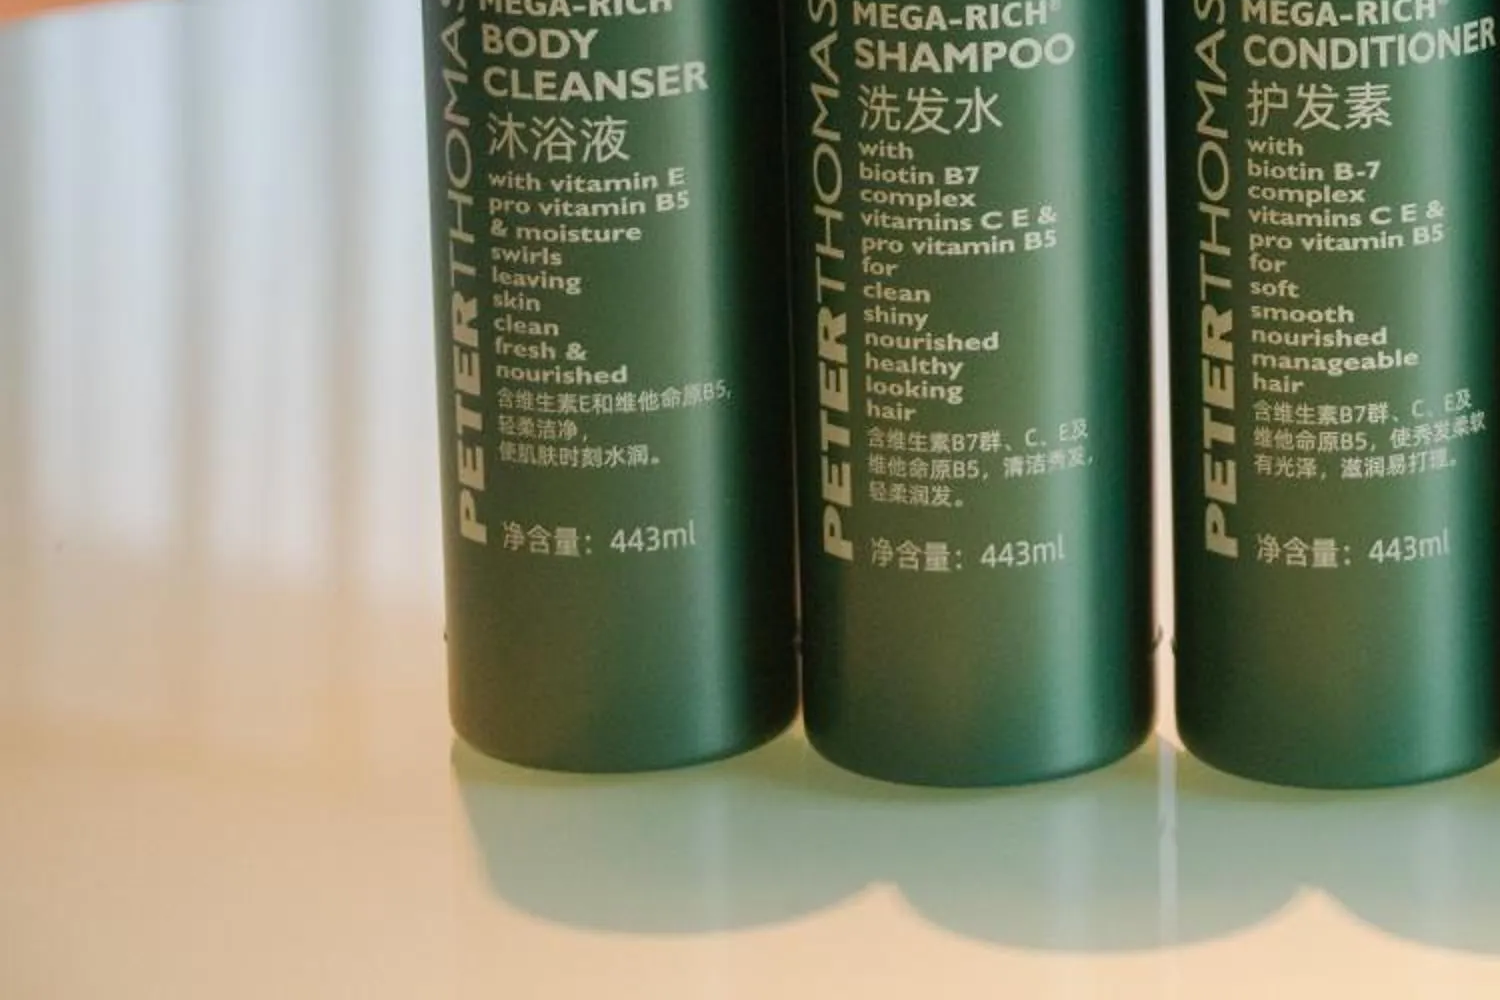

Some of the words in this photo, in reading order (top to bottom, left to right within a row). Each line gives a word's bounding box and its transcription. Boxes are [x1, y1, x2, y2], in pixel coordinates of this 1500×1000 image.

[481, 23, 599, 60] BODY
[854, 34, 1073, 74] SHAMPOO
[1242, 14, 1497, 71] CONDITIONER
[483, 61, 707, 102] CLEANSER
[858, 84, 1003, 135] 洗发水
[1246, 79, 1393, 131] 护发素
[487, 112, 630, 164] 沐浴液
[857, 139, 914, 161] with
[1246, 135, 1304, 157] with
[488, 170, 542, 192] with
[550, 171, 658, 193] vitamin
[667, 167, 685, 187] E
[859, 161, 935, 185] biotin
[944, 165, 980, 185] B7
[1247, 157, 1325, 182] biotin
[1333, 160, 1381, 181] B-7
[488, 197, 531, 216] pro
[538, 196, 646, 217] vitamin
[655, 189, 690, 213] B5
[860, 188, 977, 213] complex
[1247, 183, 1366, 209] complex
[860, 208, 973, 232] vitamins
[980, 210, 1003, 231] C
[1011, 208, 1029, 229] E
[1037, 205, 1058, 225] &
[1247, 205, 1363, 228] vitamins
[1369, 206, 1392, 226] C
[1400, 203, 1417, 223] E
[1425, 199, 1445, 220] &
[490, 217, 509, 238] &
[516, 223, 642, 243] moisture
[861, 236, 904, 255] pro
[911, 235, 1015, 256] vitamin
[1023, 229, 1057, 251] B5
[1249, 233, 1293, 252] pro
[1300, 230, 1404, 252] vitamin
[1412, 222, 1444, 246] B5
[491, 245, 563, 266] swirls
[861, 255, 899, 277] for
[1248, 251, 1287, 273] for
[492, 265, 582, 297] leaving
[863, 281, 931, 304] clean
[1249, 279, 1300, 299] soft
[492, 289, 541, 313] skin
[1250, 304, 1355, 324] smooth
[493, 313, 560, 337] clean
[863, 304, 929, 333] shiny
[495, 335, 557, 361] fresh
[565, 341, 587, 361] &
[865, 331, 999, 352] nourished
[1251, 326, 1388, 348] nourished
[496, 364, 628, 385] nourished
[865, 351, 964, 381] healthy
[1251, 348, 1419, 377] manageable
[865, 375, 964, 405] looking
[1252, 371, 1305, 393] hair
[866, 398, 917, 422] hair
